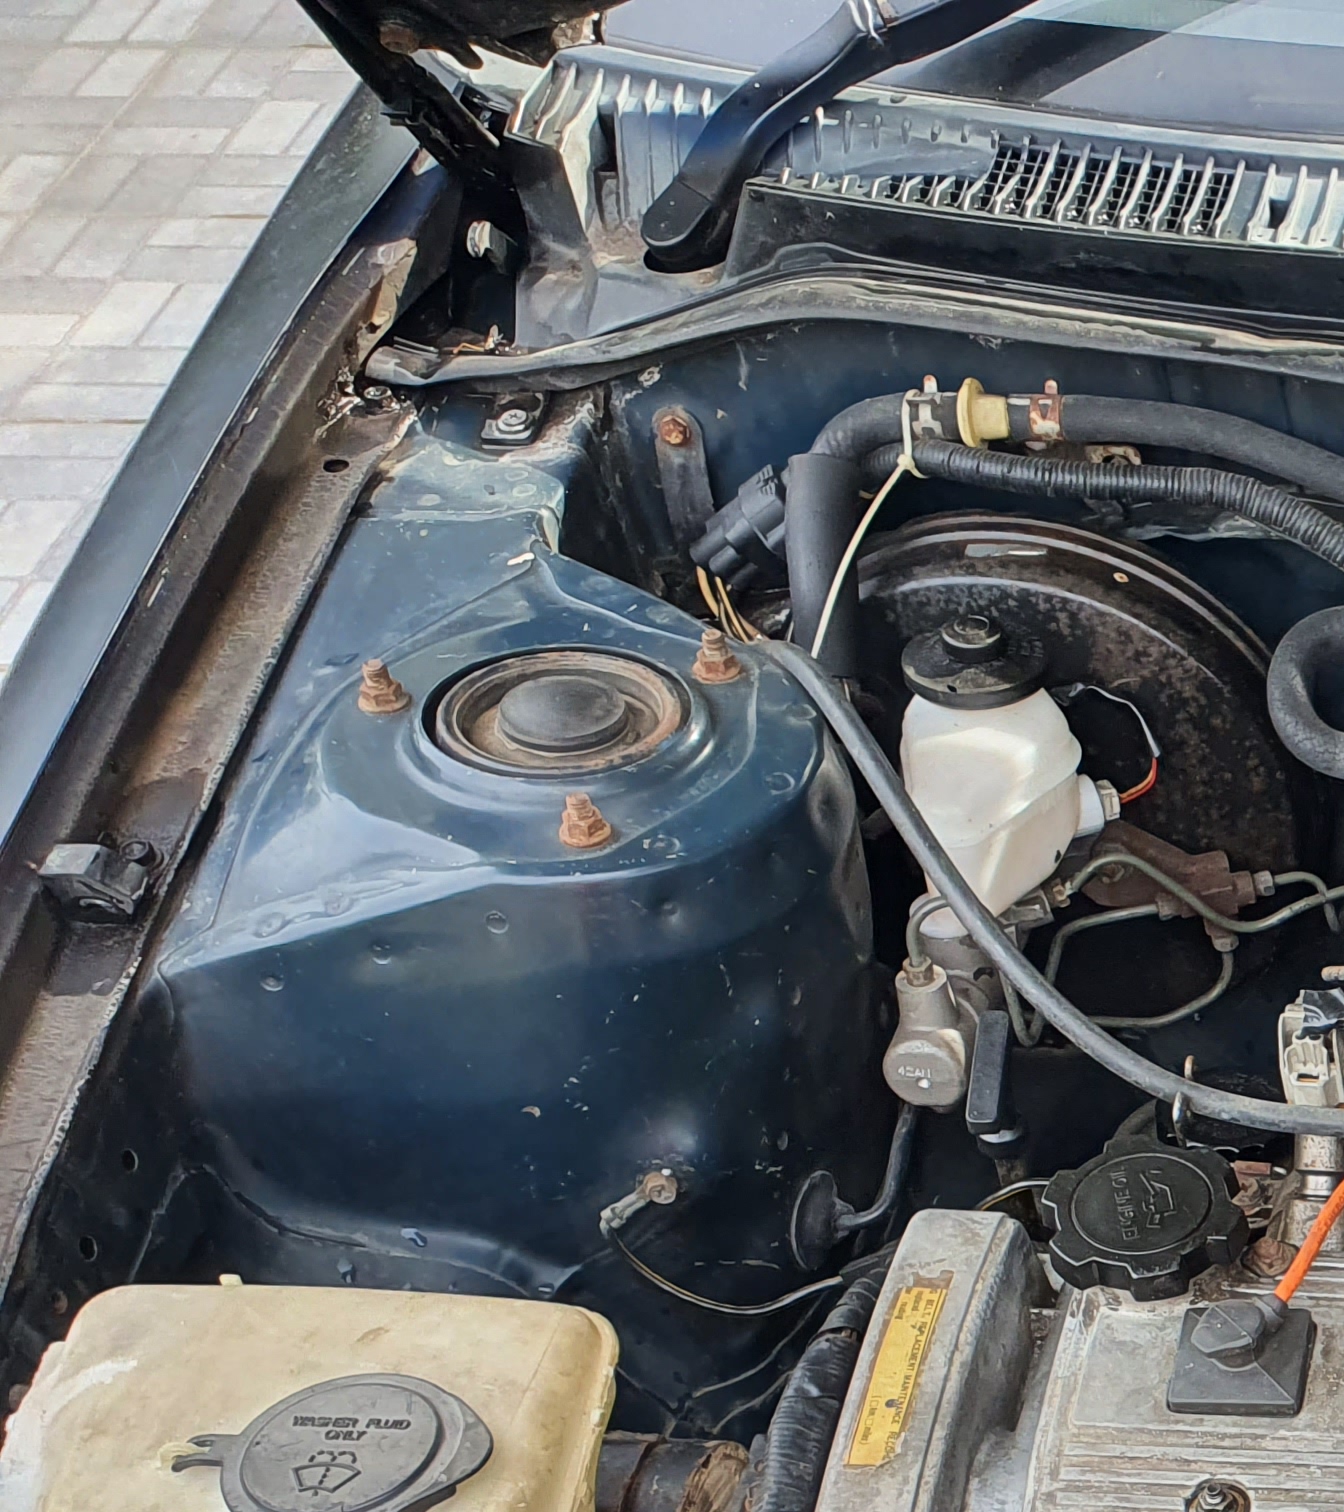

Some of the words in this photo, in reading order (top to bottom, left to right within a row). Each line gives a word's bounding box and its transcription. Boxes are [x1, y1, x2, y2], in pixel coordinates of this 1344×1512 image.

[292, 1415, 360, 1428] WASHER
[365, 1418, 411, 1430] FLUID
[325, 1429, 368, 1441] ONLY
